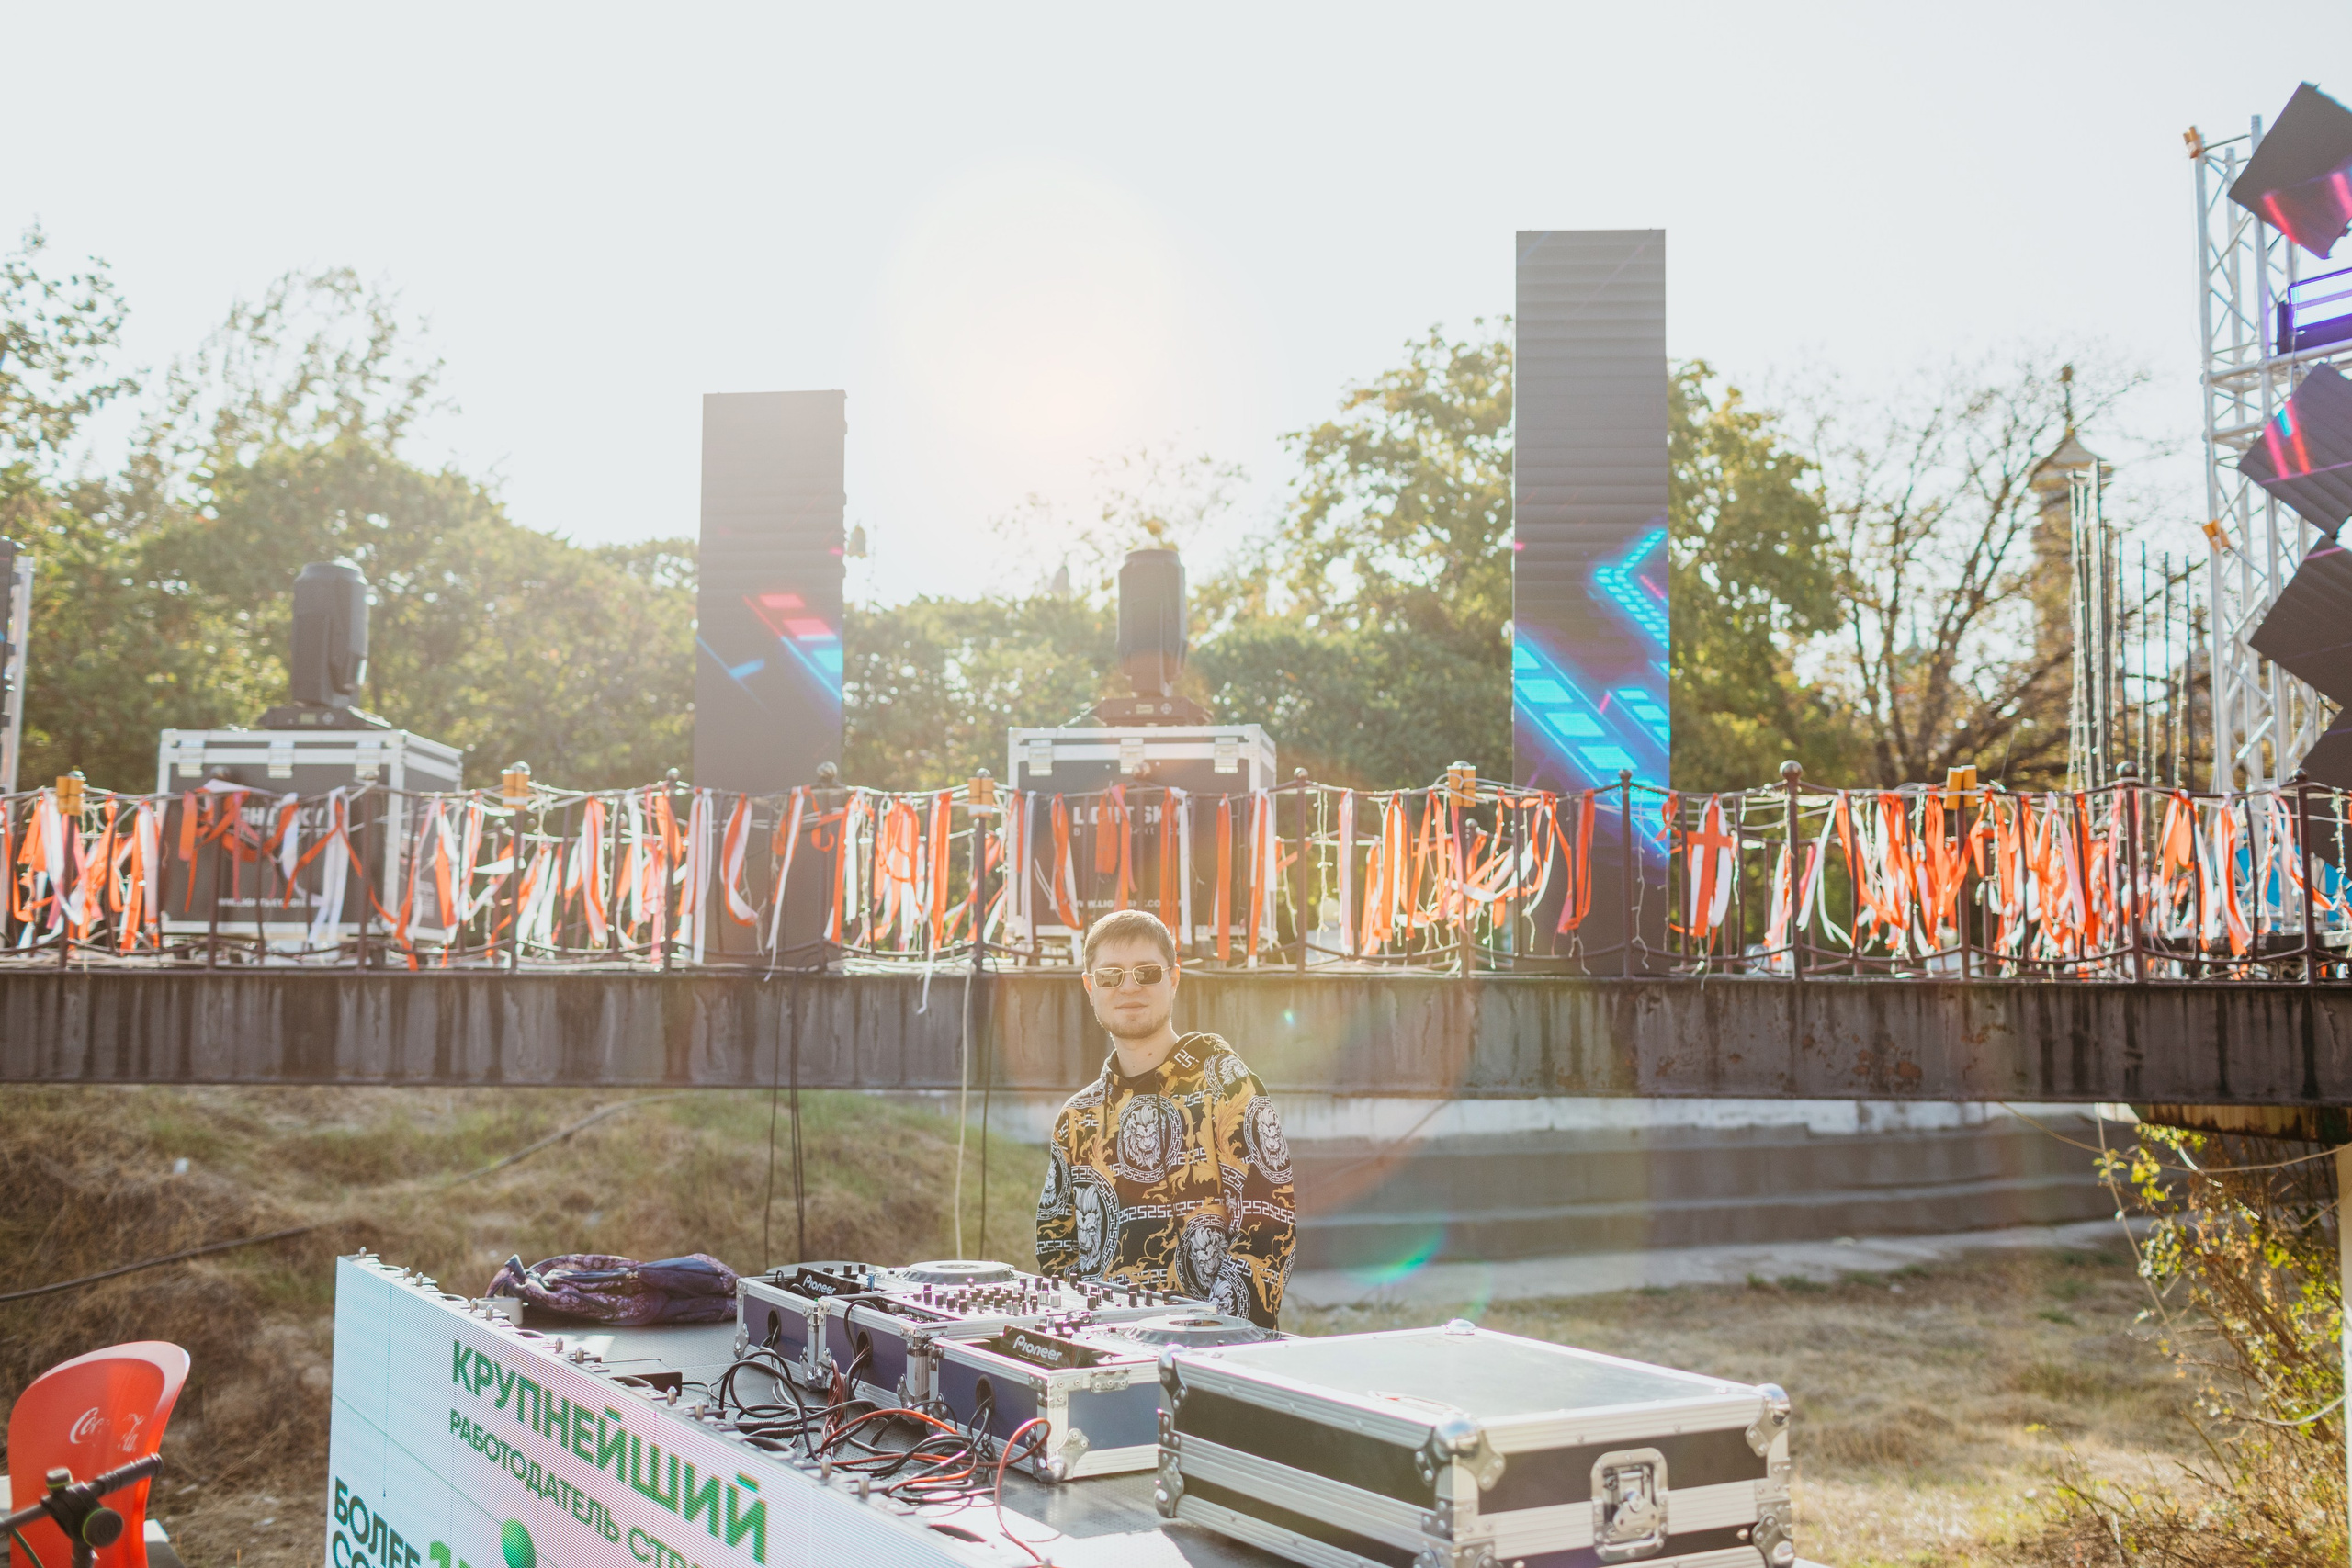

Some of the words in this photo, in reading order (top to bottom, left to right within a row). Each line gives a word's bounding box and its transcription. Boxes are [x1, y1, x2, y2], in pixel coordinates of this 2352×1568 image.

[802, 1274, 837, 1295] Pioneer
[1012, 1334, 1063, 1361] Pioneer
[449, 1408, 621, 1543] РАБОТОДАТЕЛЬ
[628, 1526, 704, 1568] СТР
[452, 1338, 768, 1566] КРУПНЕЙШИЙ
